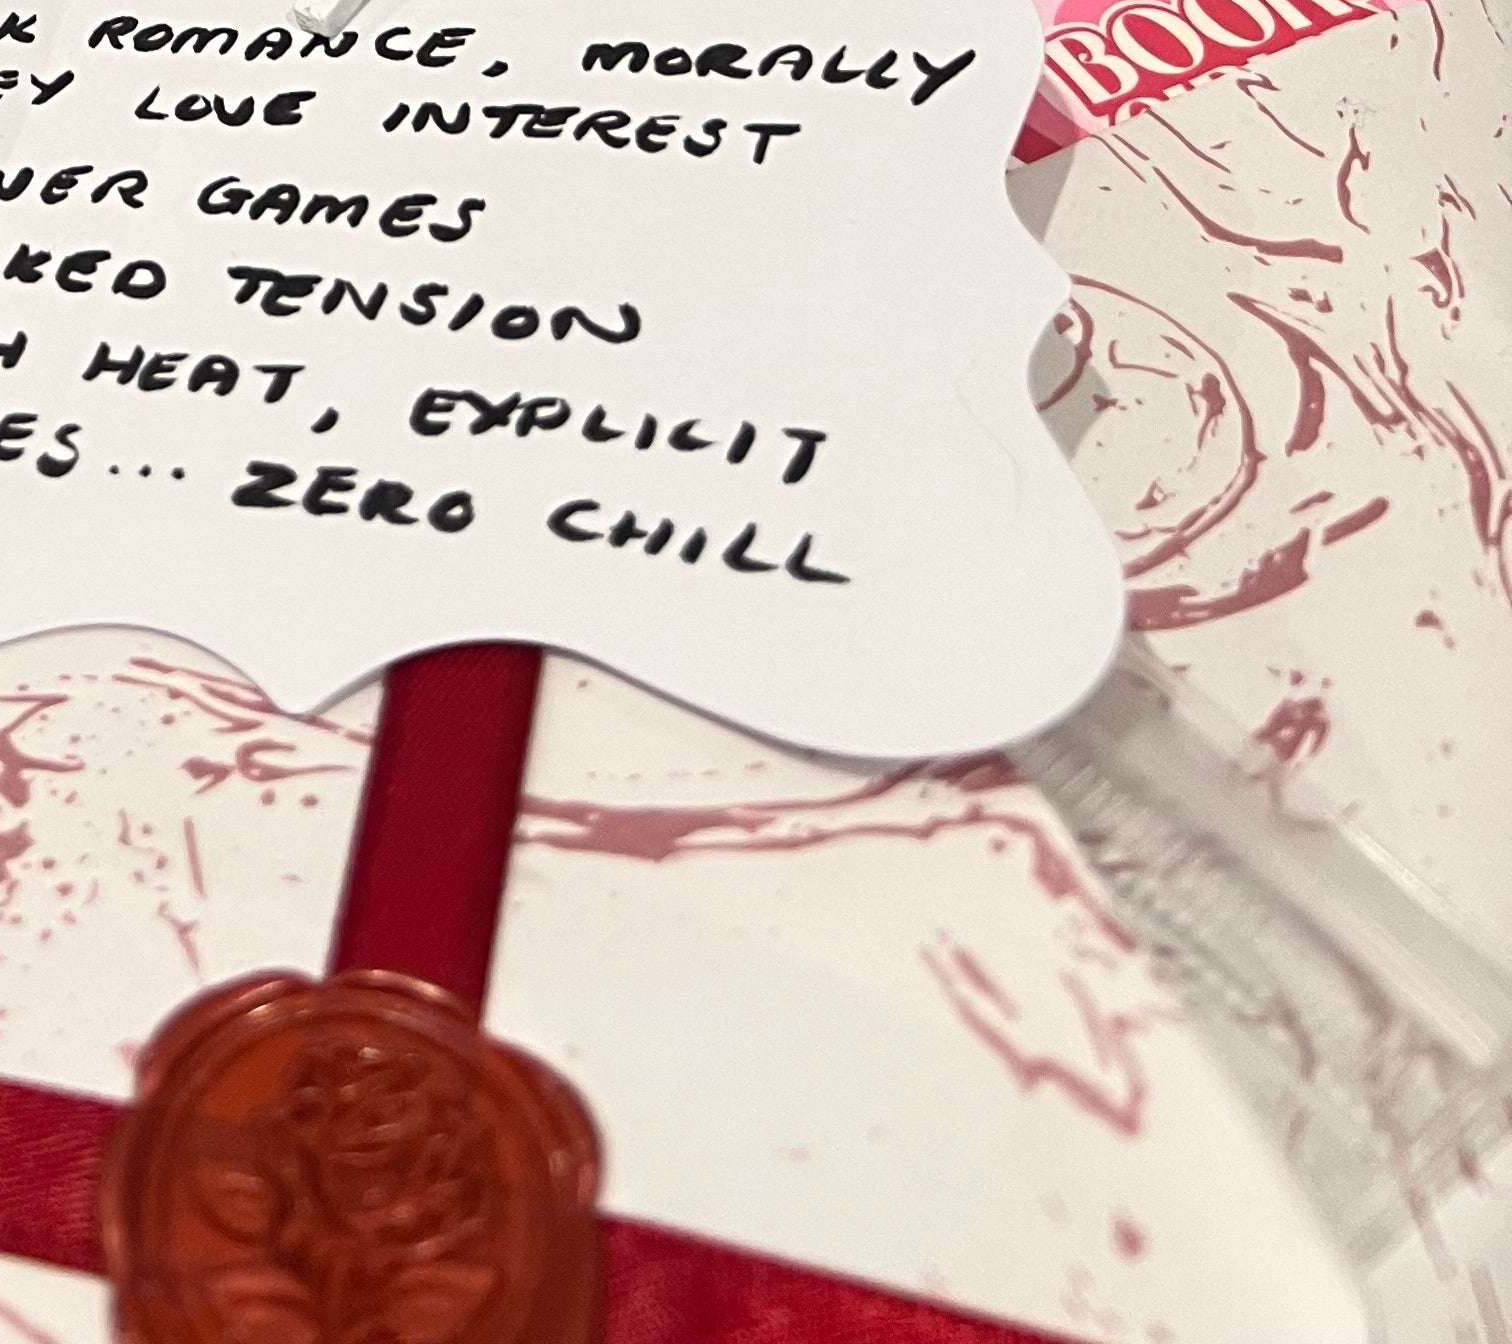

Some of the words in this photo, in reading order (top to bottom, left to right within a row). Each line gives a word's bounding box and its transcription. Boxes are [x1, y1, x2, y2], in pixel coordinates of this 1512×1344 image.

[581, 42, 977, 105] MORALLY
[134, 87, 317, 127] LOVE
[382, 102, 801, 165] INTEREST
[197, 175, 487, 243] GAMES
[227, 265, 642, 344] TENSION
[409, 387, 827, 484] EXPLICIT
[230, 459, 476, 533] ZERO
[546, 498, 851, 586] CHILL
